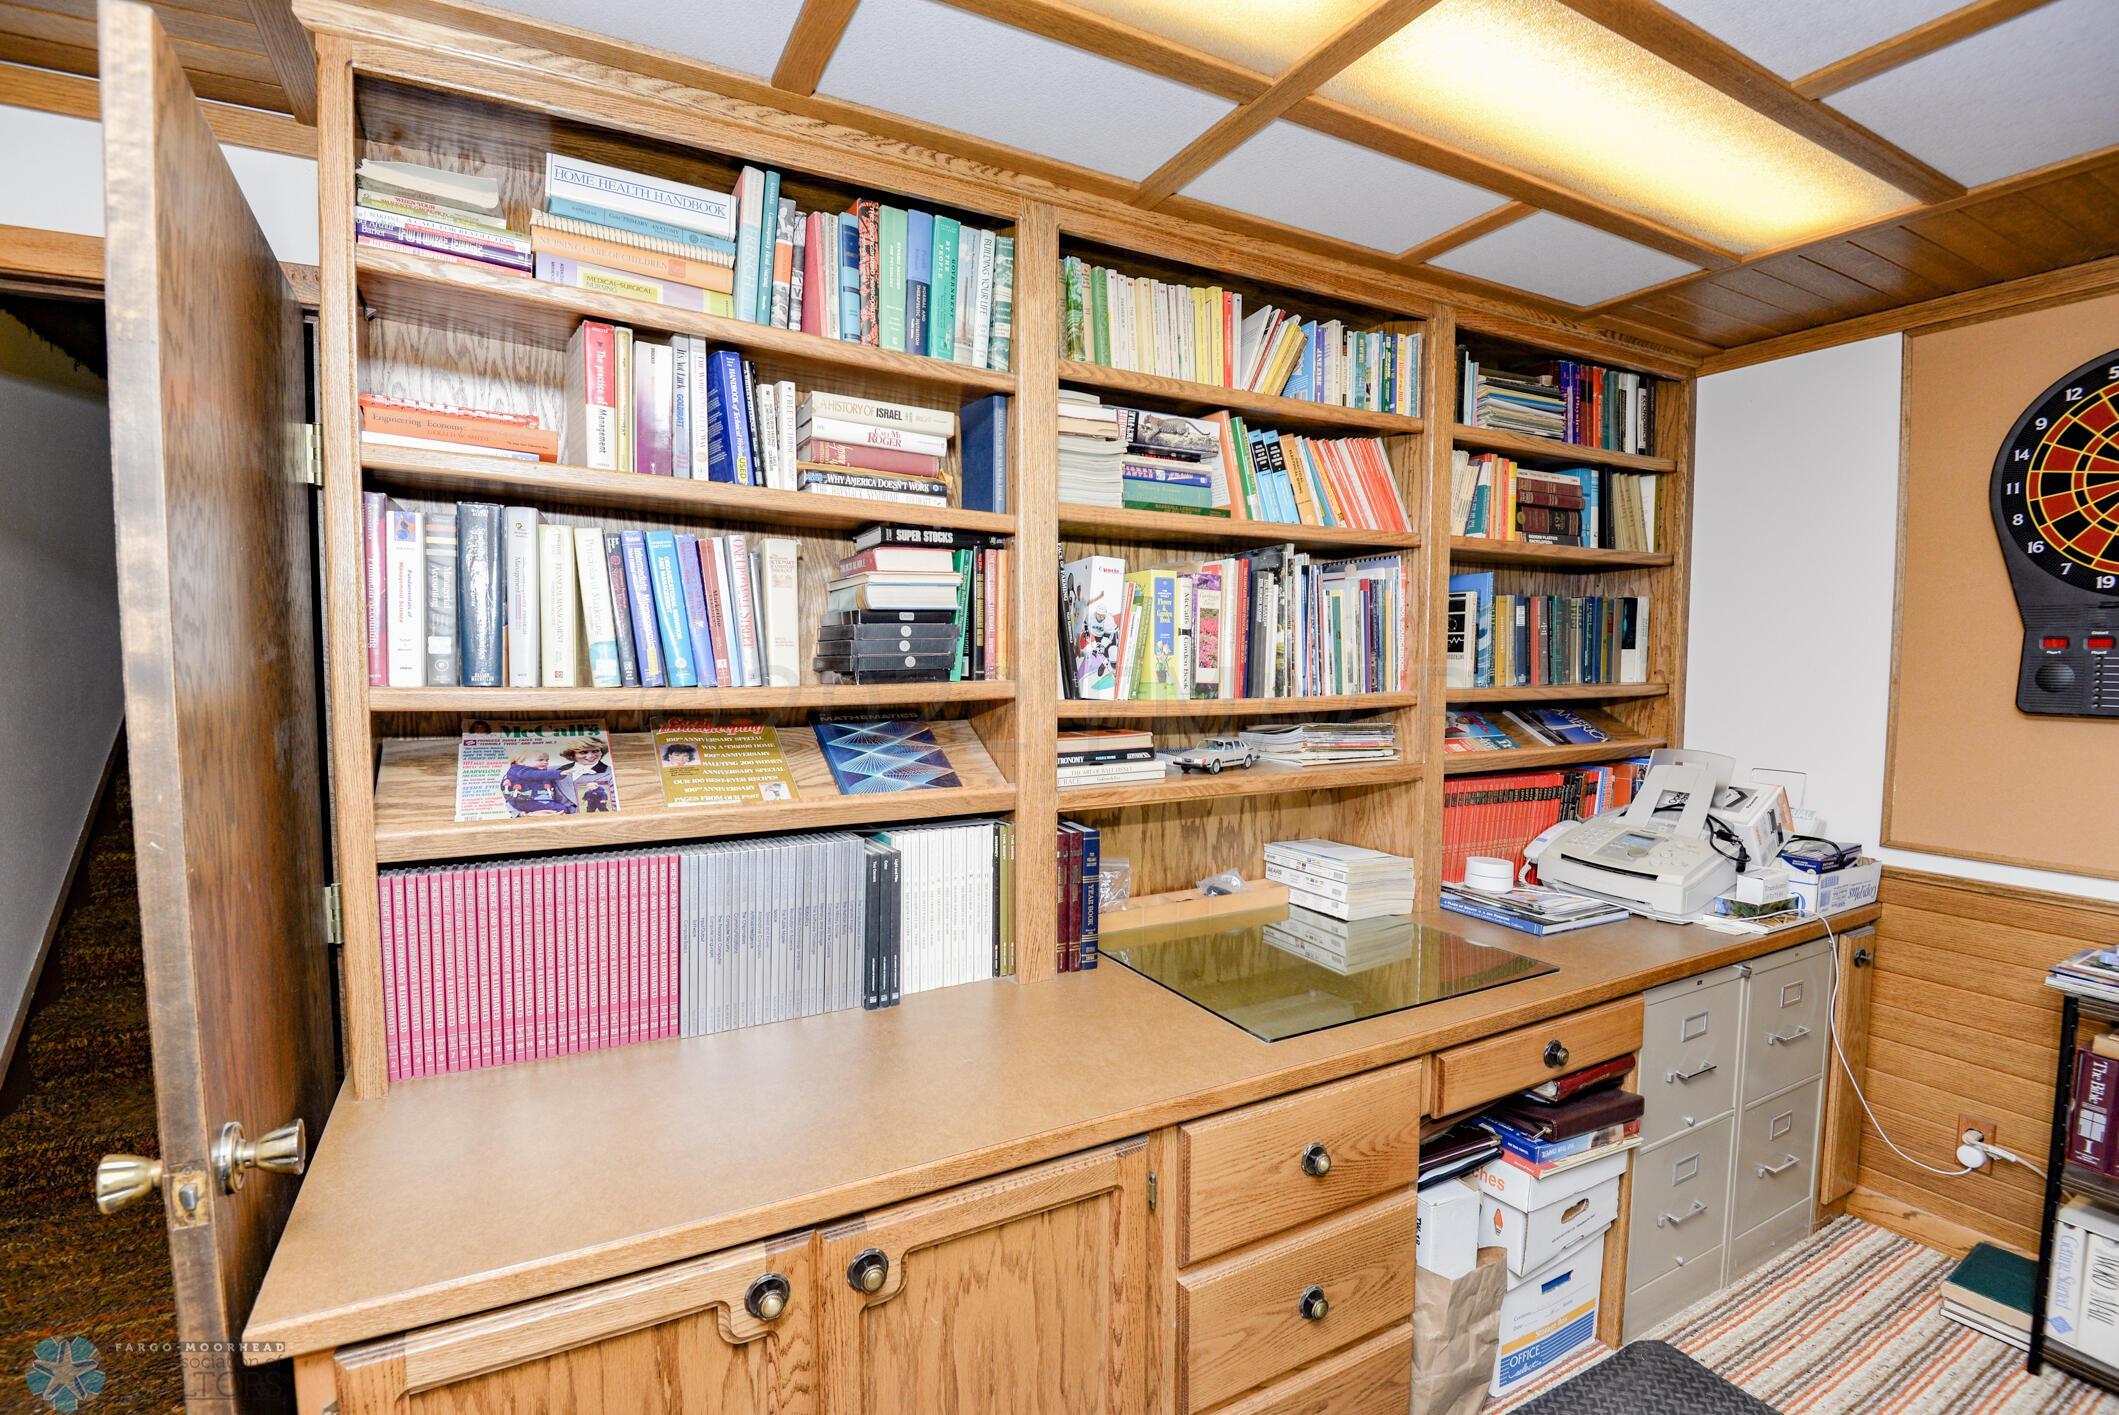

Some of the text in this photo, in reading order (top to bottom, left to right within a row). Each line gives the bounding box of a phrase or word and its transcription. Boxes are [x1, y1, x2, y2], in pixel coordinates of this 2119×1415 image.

[554, 167, 727, 218] HOME HEALTH HANDBOOK
[541, 236, 582, 251] NURSING
[585, 245, 610, 256] CARE
[620, 252, 668, 271] CHILDREN
[743, 226, 759, 288] FRENCH
[586, 275, 652, 296] MEDICAL-SURGICAL
[979, 238, 993, 315] BUILDING YOUR LIFE
[676, 348, 687, 361] It's
[676, 373, 686, 389] Luck
[729, 368, 740, 403] HANDBOOK
[595, 350, 608, 454] The practice of Management
[786, 395, 794, 411] FREE
[2065, 387, 2083, 402] 12
[676, 393, 685, 428] GOLDRATT
[828, 400, 903, 421] HISTORY OF ISRAEL
[373, 413, 465, 433] Engineering Economy
[732, 412, 743, 437] Technical
[2034, 417, 2048, 430] 9
[867, 432, 902, 448] ROGER
[2013, 448, 2030, 462] 14
[739, 457, 747, 480] USED
[826, 473, 930, 492] WHY AMERICA DOESN'T WORK
[2005, 482, 2020, 495] 11
[2012, 513, 2024, 526] 8
[896, 529, 954, 544] SUPER STOCKS
[2026, 540, 2045, 554] 16
[634, 547, 647, 591] Intermediate
[2060, 562, 2073, 575] 7
[430, 565, 441, 609] Accounting
[442, 566, 452, 609] Managerial
[660, 569, 672, 614] MANAGEMENT
[1060, 570, 1069, 602] FARMING
[2096, 574, 2116, 589] 19
[664, 556, 682, 639] ORGANIZATIONAL BEHAVIOR
[732, 540, 755, 649] ONE STREET
[712, 590, 722, 627] Marketing
[556, 599, 564, 644] MANAGEMENT
[1184, 670, 1192, 690] Book
[820, 712, 919, 722] MATHEMATICS
[501, 723, 601, 738] McCall's
[656, 724, 765, 735] Housekeeping
[1057, 755, 1085, 765] TRONOMY
[703, 785, 755, 793] ANNIVERSARY
[2091, 1060, 2108, 1105] The Bible
[2055, 1234, 2079, 1311] Getting Started
[1509, 1344, 1541, 1368] OFFICE
